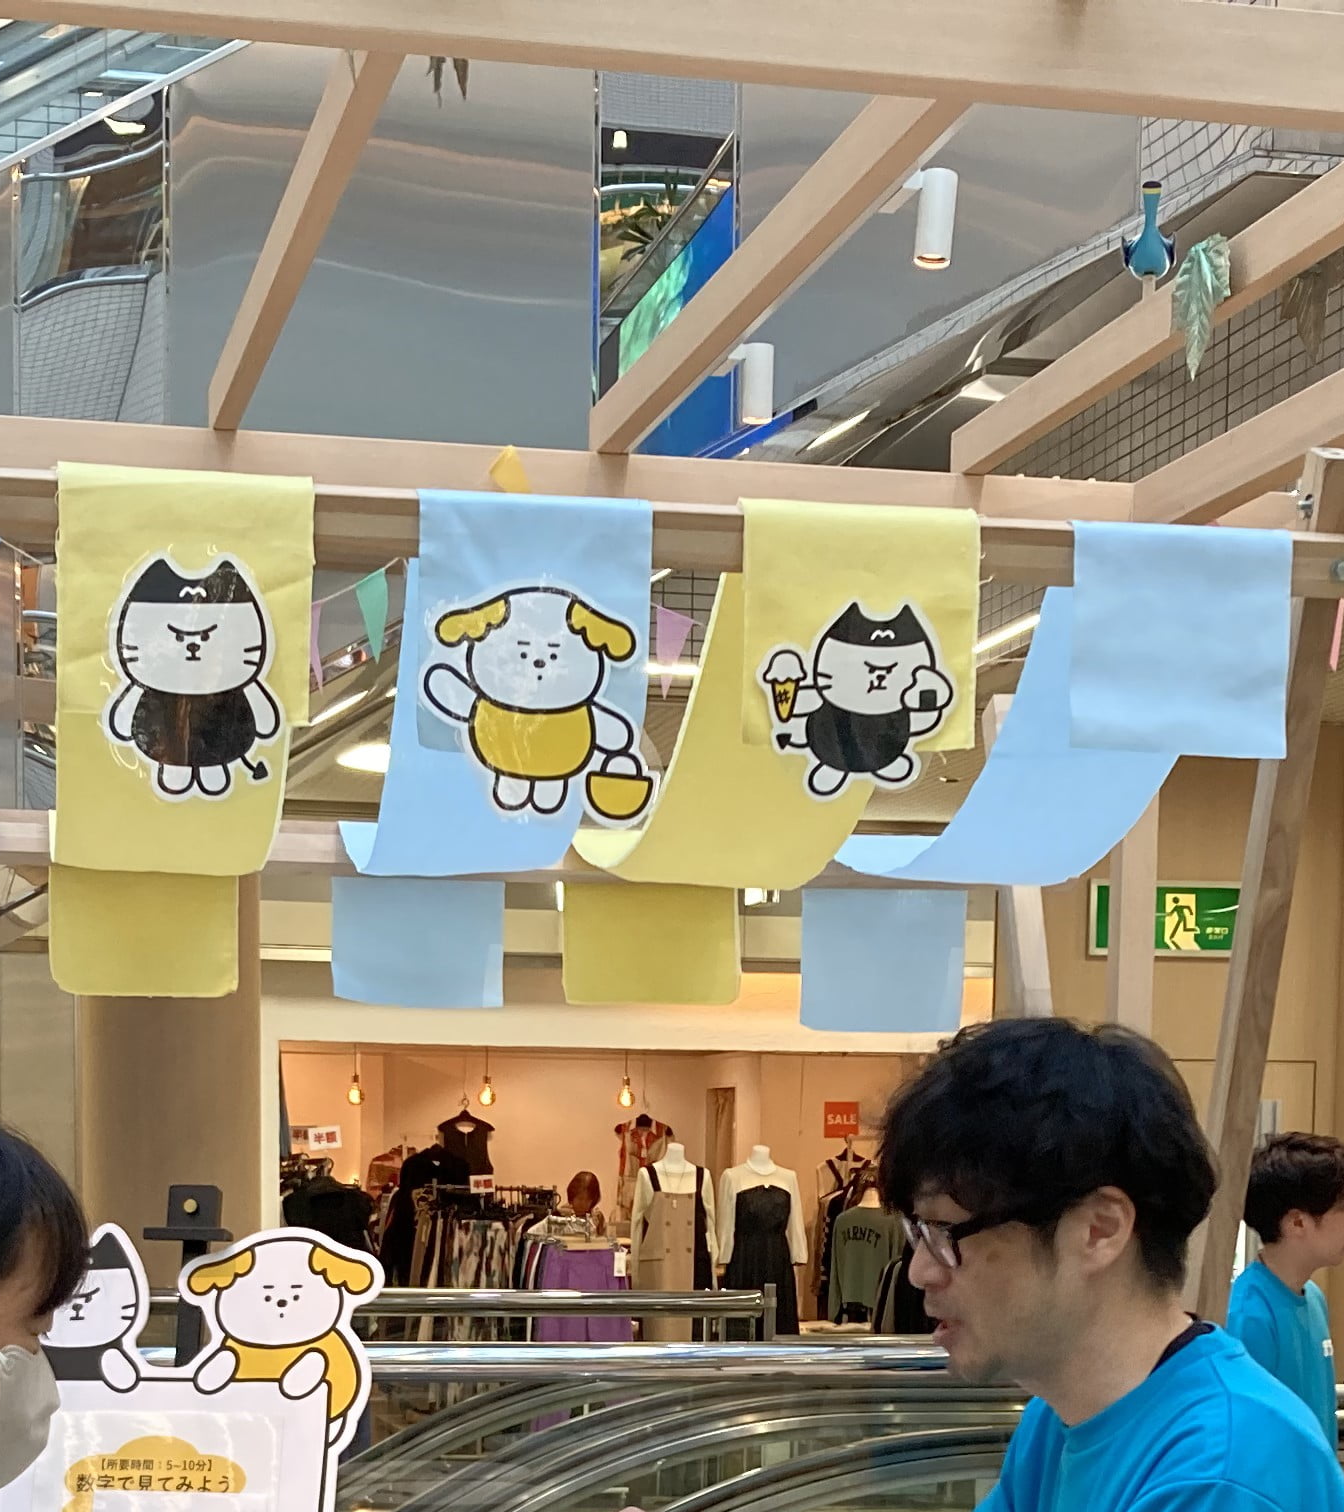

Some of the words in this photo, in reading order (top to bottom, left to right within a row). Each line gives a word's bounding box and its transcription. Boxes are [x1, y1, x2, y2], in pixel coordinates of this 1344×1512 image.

[826, 1113, 858, 1125] SALE
[75, 1473, 231, 1493] 数字で見てみよう
